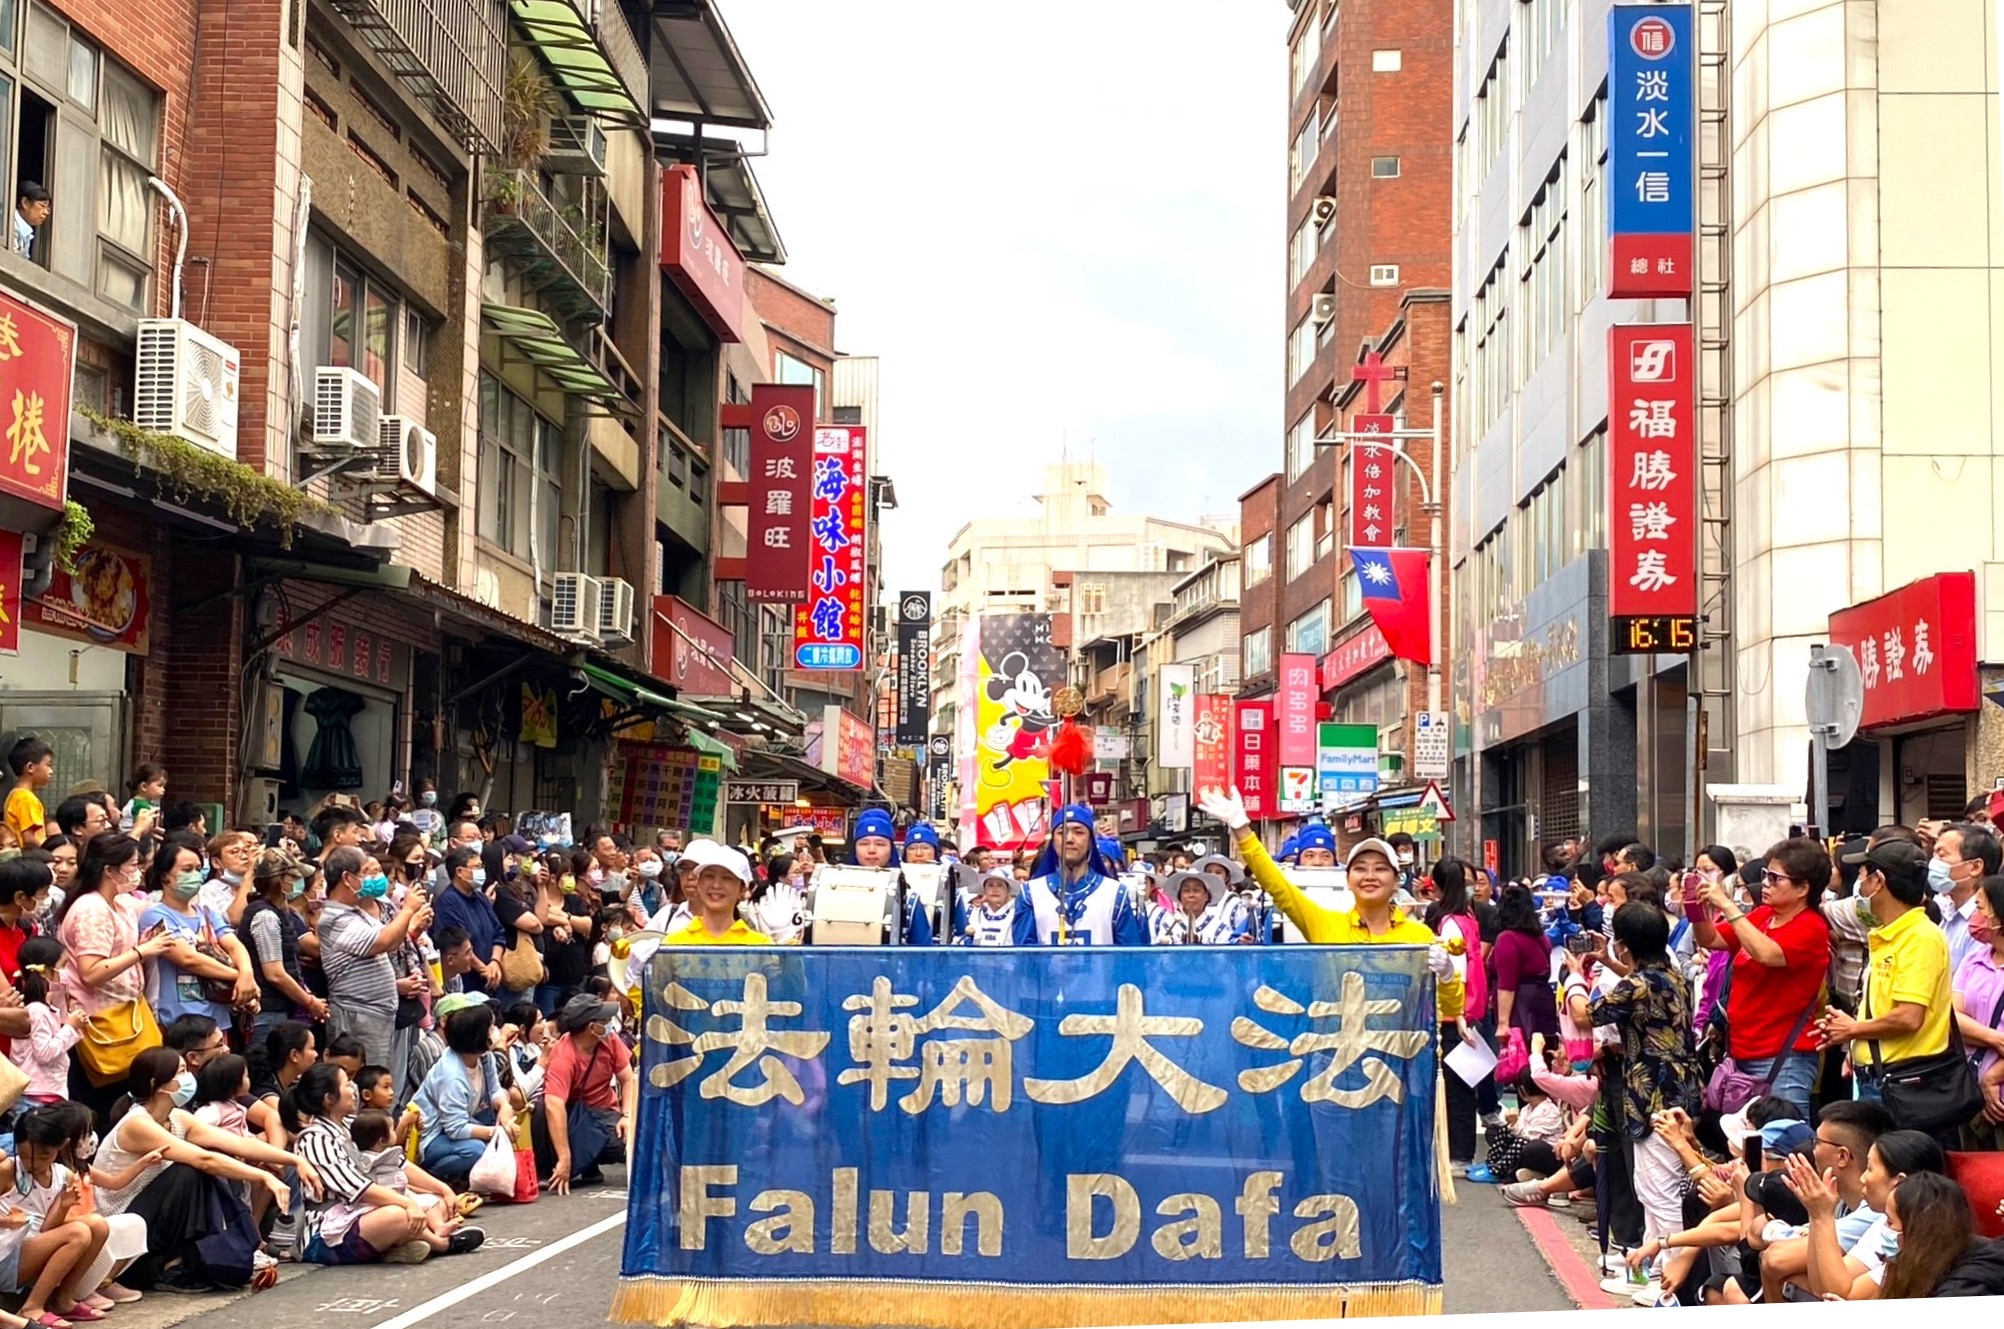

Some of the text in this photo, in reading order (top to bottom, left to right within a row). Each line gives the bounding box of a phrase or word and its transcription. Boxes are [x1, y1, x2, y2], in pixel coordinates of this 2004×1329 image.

[1635, 71, 1670, 202] 淡水一信
[1630, 257, 1675, 274] 總社
[764, 456, 798, 548] 波羅旺
[1629, 398, 1677, 591] 福勝證券
[811, 455, 848, 641] 海味小館
[917, 630, 928, 708] BROOKLYN
[1629, 618, 1693, 648] 16:15
[1849, 618, 1934, 690] 勝證券
[1320, 752, 1376, 766] FamilyMart
[646, 971, 1430, 1114] 法輪大法
[679, 1163, 1363, 1262] Falun Dafa
